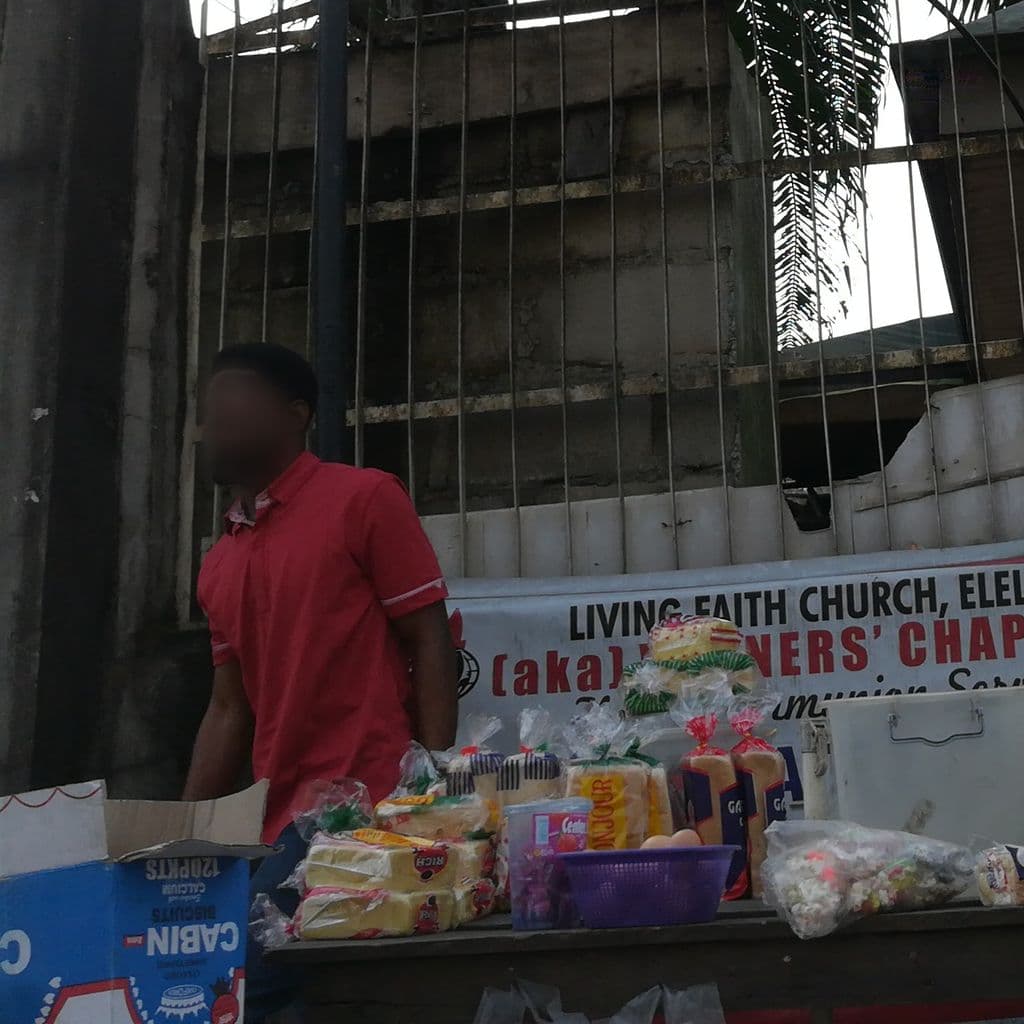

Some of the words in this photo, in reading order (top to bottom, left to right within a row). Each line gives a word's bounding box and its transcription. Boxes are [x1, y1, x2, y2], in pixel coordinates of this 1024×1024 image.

[570, 597, 682, 641] LIVING
[695, 589, 786, 627] FAITH
[799, 577, 948, 622] CHURCH,
[146, 922, 240, 956] CABIN
